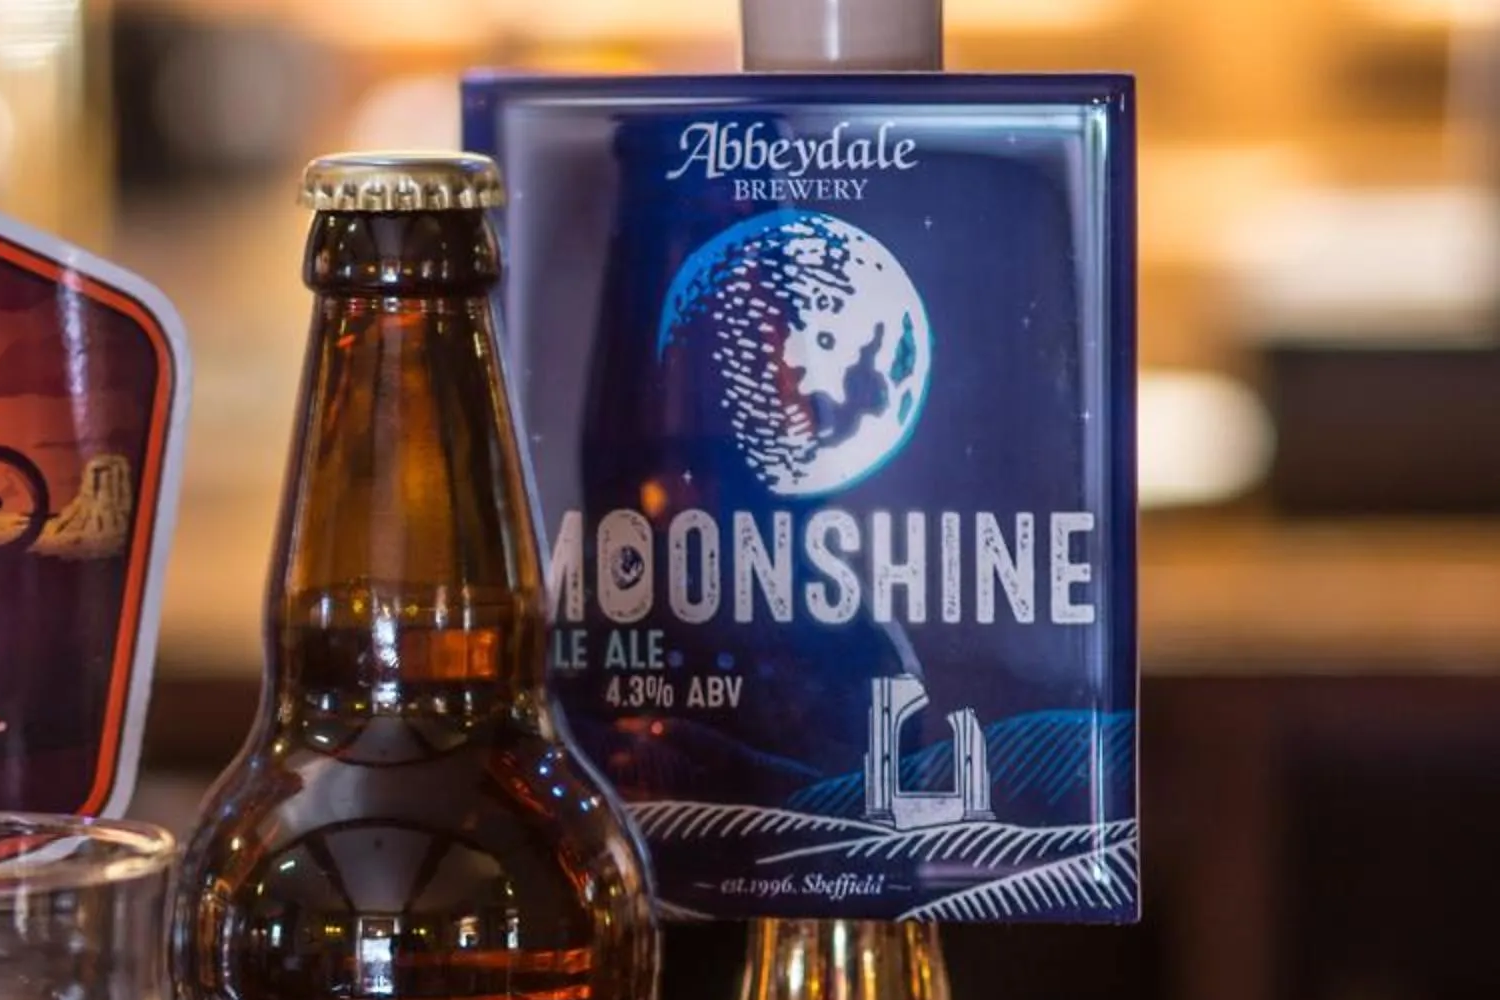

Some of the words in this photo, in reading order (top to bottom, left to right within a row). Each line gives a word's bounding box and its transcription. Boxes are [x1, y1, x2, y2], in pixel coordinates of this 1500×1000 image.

[666, 121, 919, 180] Abbeydale
[734, 178, 867, 201] BREWERY
[554, 629, 588, 669] LE
[605, 629, 665, 670] ALE
[606, 676, 674, 707] 4.3%
[687, 676, 743, 708] ABV
[802, 873, 885, 900] Sheffield
